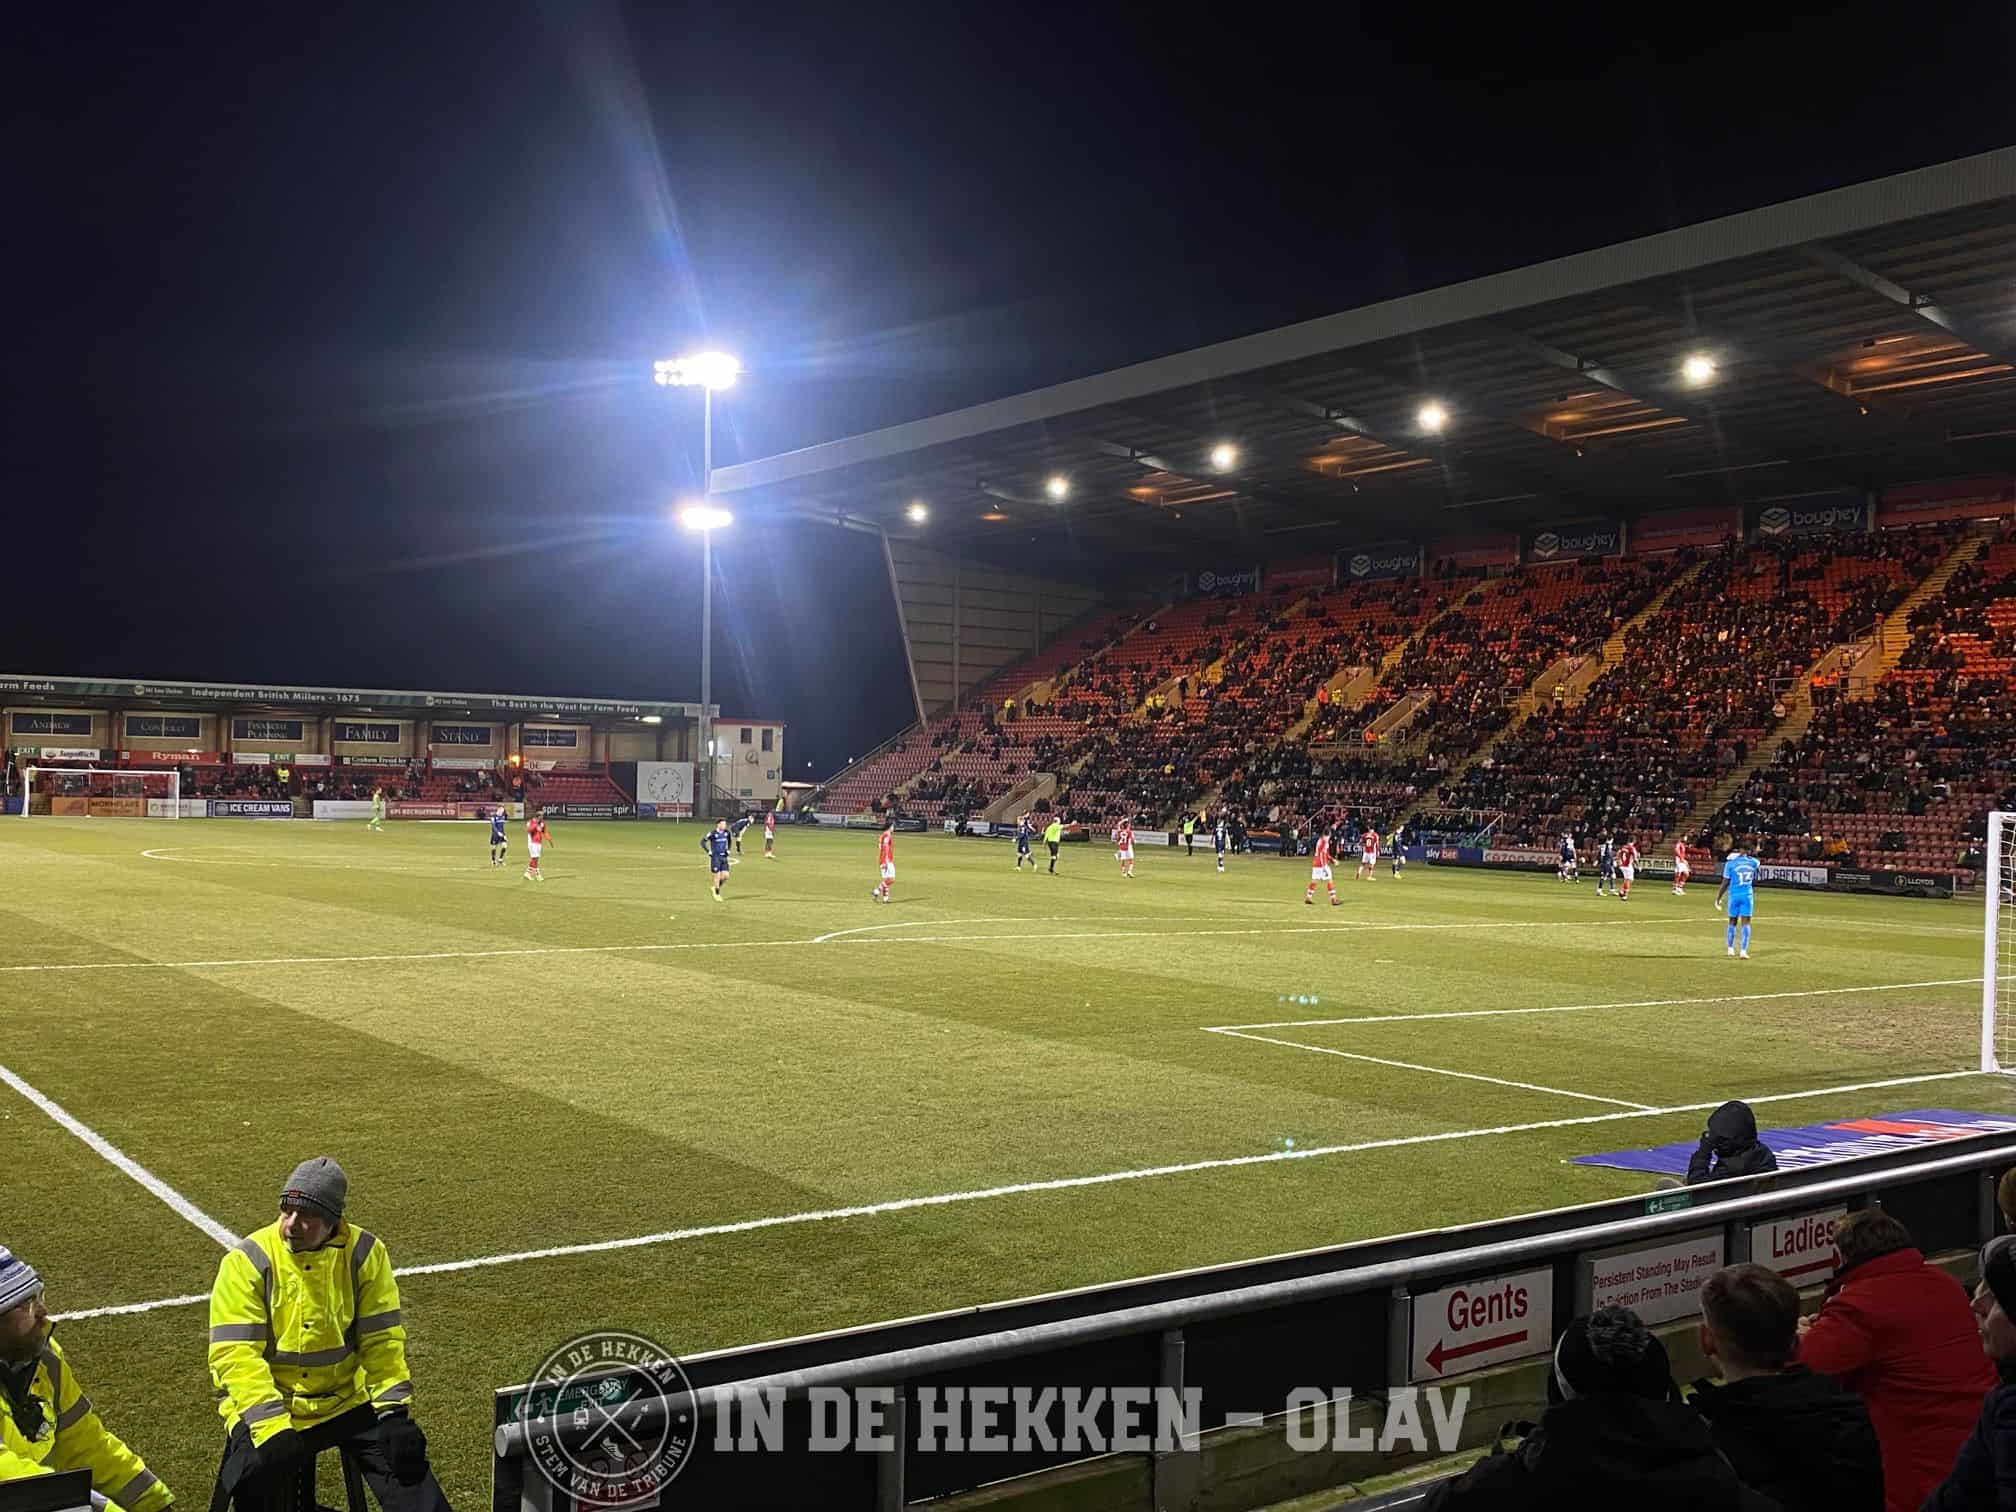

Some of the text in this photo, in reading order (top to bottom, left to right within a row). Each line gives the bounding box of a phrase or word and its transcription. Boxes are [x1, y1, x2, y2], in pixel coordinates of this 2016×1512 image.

[1793, 505, 1861, 527] boughey
[1561, 531, 1617, 551] boughey
[1372, 554, 1418, 571] boughey
[191, 687, 255, 700] Independent
[258, 691, 290, 701] British
[293, 692, 325, 702] Millers
[509, 701, 527, 710] Best
[556, 703, 577, 712] West
[345, 727, 388, 741] FAMILY
[440, 728, 480, 742] STAND
[152, 751, 200, 761] Ryman
[230, 803, 291, 813] ICE CREAM VANS
[1426, 849, 1457, 860] sky bet
[1737, 871, 1753, 886] 13
[1772, 1215, 1836, 1259] Ladies
[1592, 1250, 1716, 1289] Persistent Standing May Result
[1641, 1287, 1662, 1302] From
[1664, 1282, 1679, 1297] The
[1679, 1278, 1701, 1293] Stad
[1447, 1283, 1528, 1332] Gents
